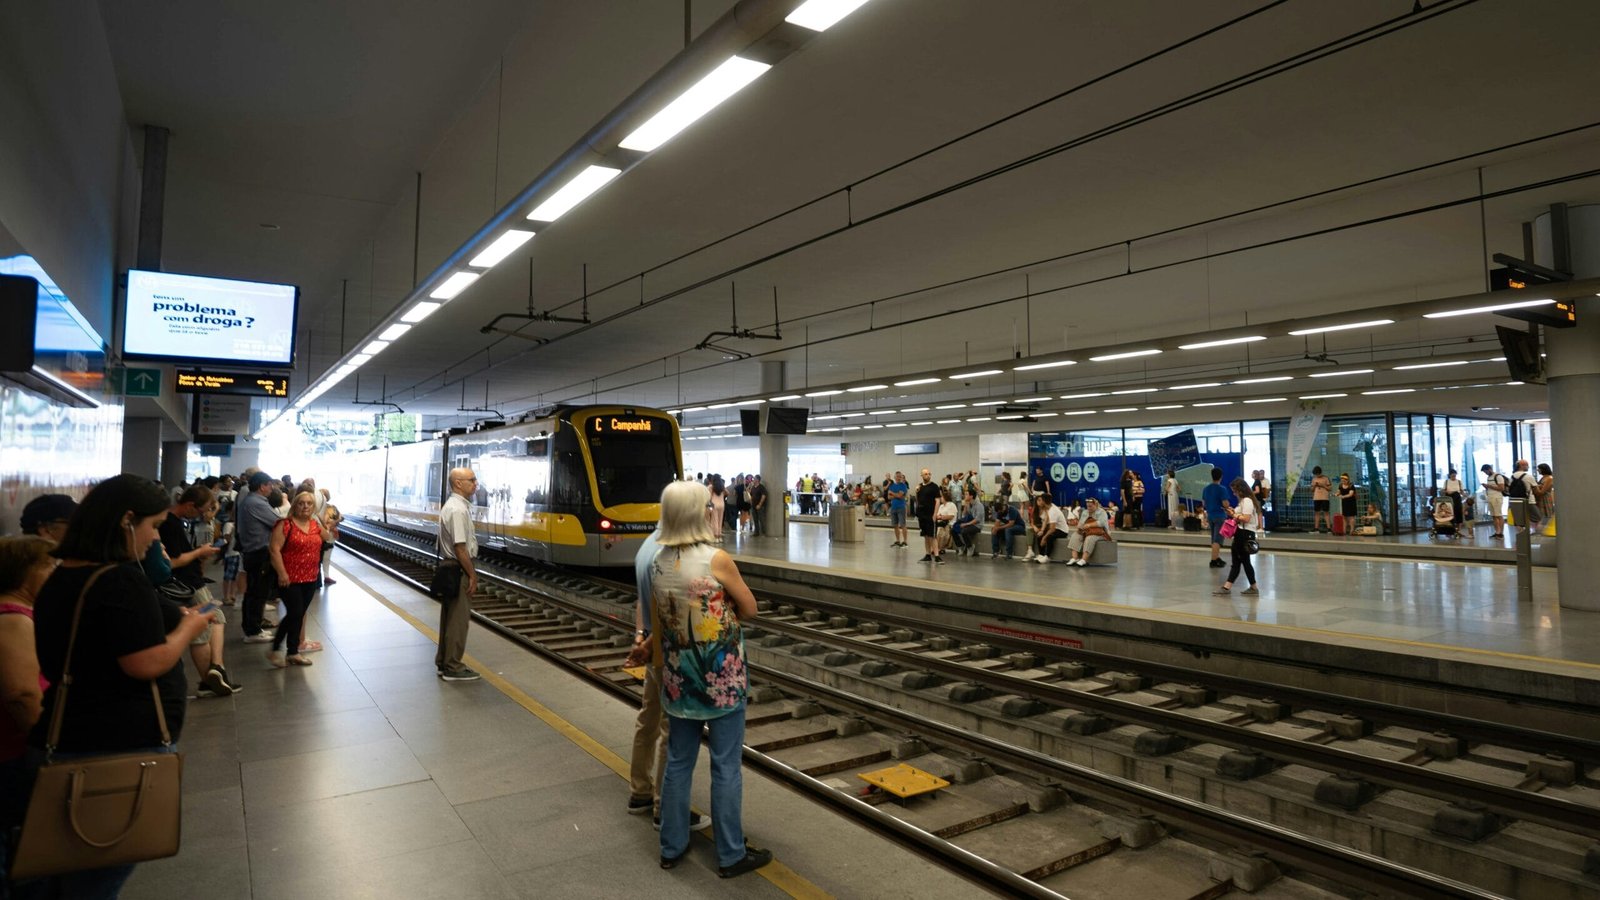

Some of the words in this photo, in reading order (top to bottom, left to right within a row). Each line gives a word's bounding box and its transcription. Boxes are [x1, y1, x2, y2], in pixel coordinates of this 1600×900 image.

[153, 302, 236, 316] problema
[595, 417, 602, 431] C
[611, 417, 651, 432] Campanhã
